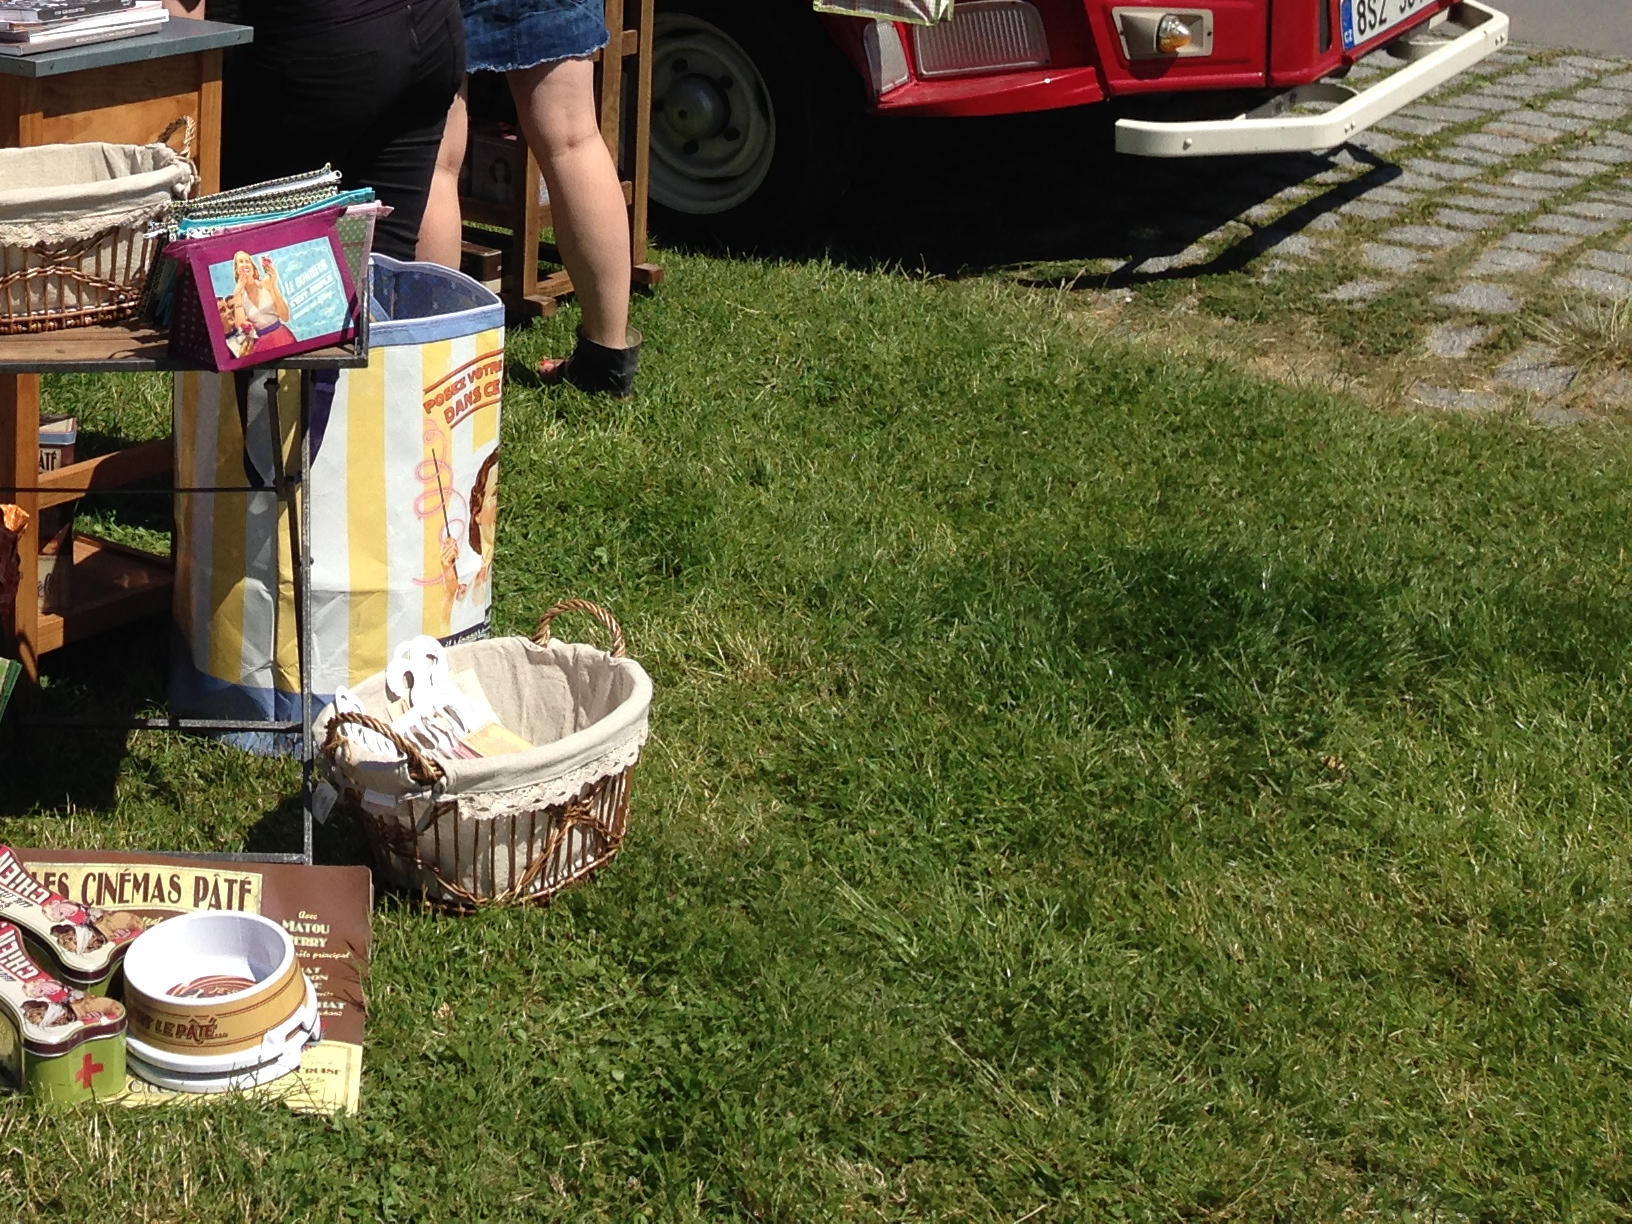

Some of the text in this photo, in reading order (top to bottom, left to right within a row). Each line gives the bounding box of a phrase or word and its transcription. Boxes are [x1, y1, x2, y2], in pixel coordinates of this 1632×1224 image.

[1344, 28, 1353, 44] CZ
[423, 376, 467, 415] POSEZ
[443, 378, 501, 425] DANS CE
[31, 867, 253, 912] ES CINÉMAS PÂTÉ
[298, 910, 318, 920] Avec
[282, 919, 330, 934] MATOU
[155, 1019, 174, 1038] LE
